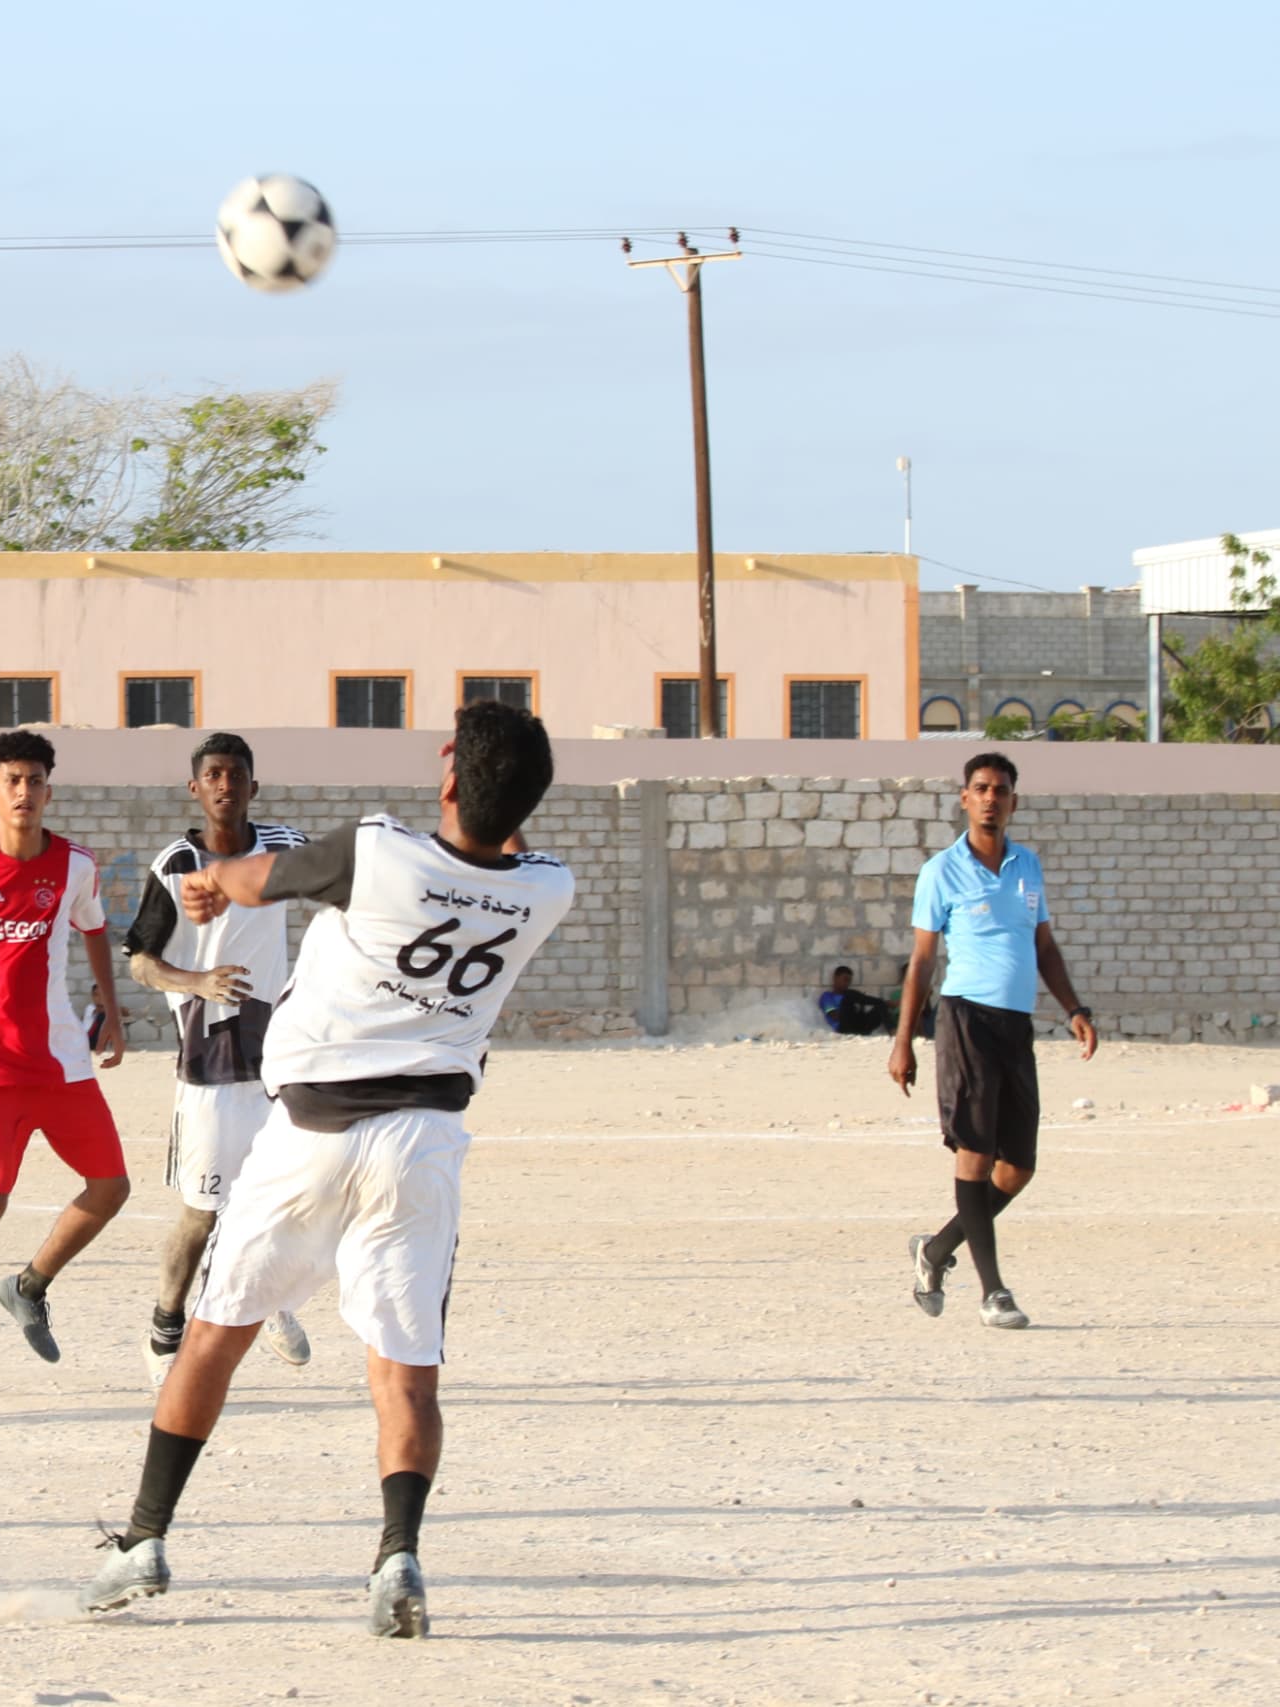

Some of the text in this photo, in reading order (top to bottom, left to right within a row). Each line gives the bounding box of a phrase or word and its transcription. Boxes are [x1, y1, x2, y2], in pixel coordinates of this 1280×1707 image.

[480, 895, 531, 923] وحدة
[396, 917, 518, 997] 66
[199, 1174, 222, 1195] 12
